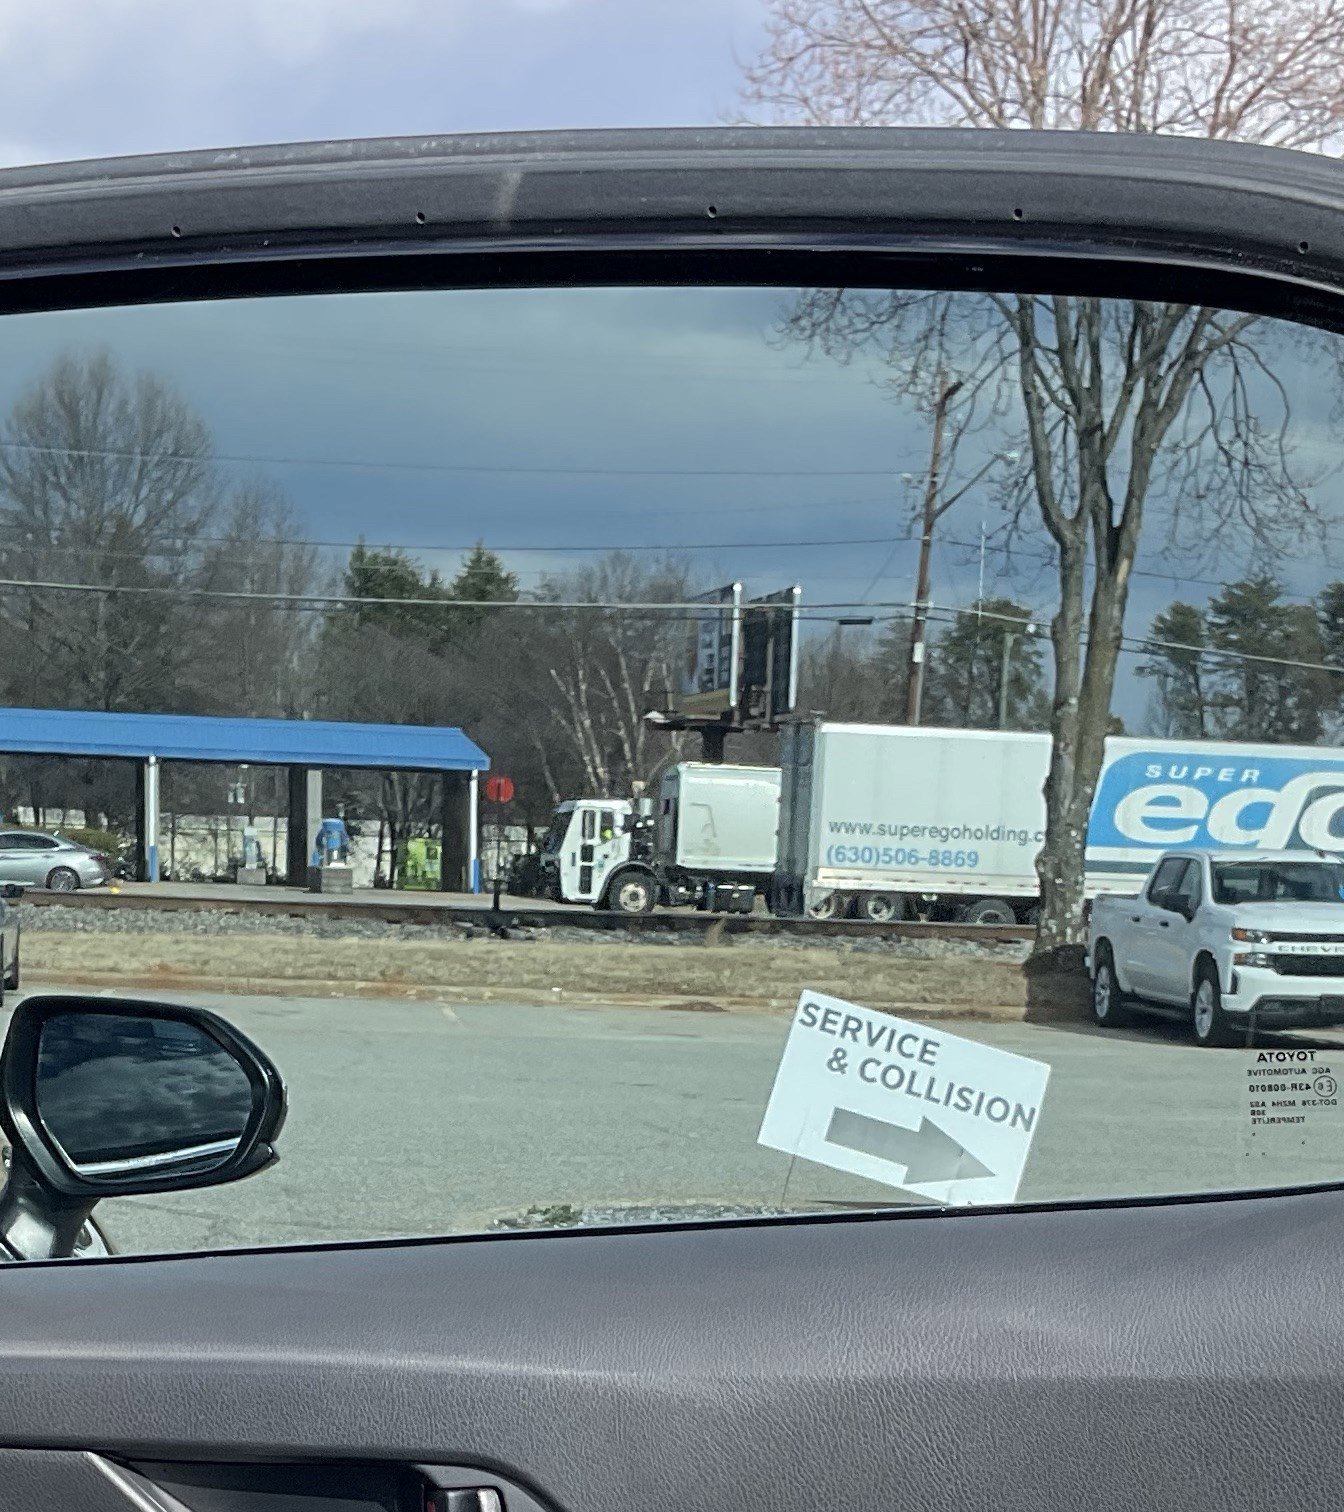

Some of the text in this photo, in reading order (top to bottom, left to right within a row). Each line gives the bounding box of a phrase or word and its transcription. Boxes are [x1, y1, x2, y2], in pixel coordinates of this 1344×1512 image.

[1145, 764, 1261, 783] SUPER
[828, 821, 1045, 847] www.superegoholding.c
[827, 844, 980, 868] (630)506-8869
[798, 1002, 941, 1066] SERVICE
[826, 1047, 1037, 1133] & COLLISION
